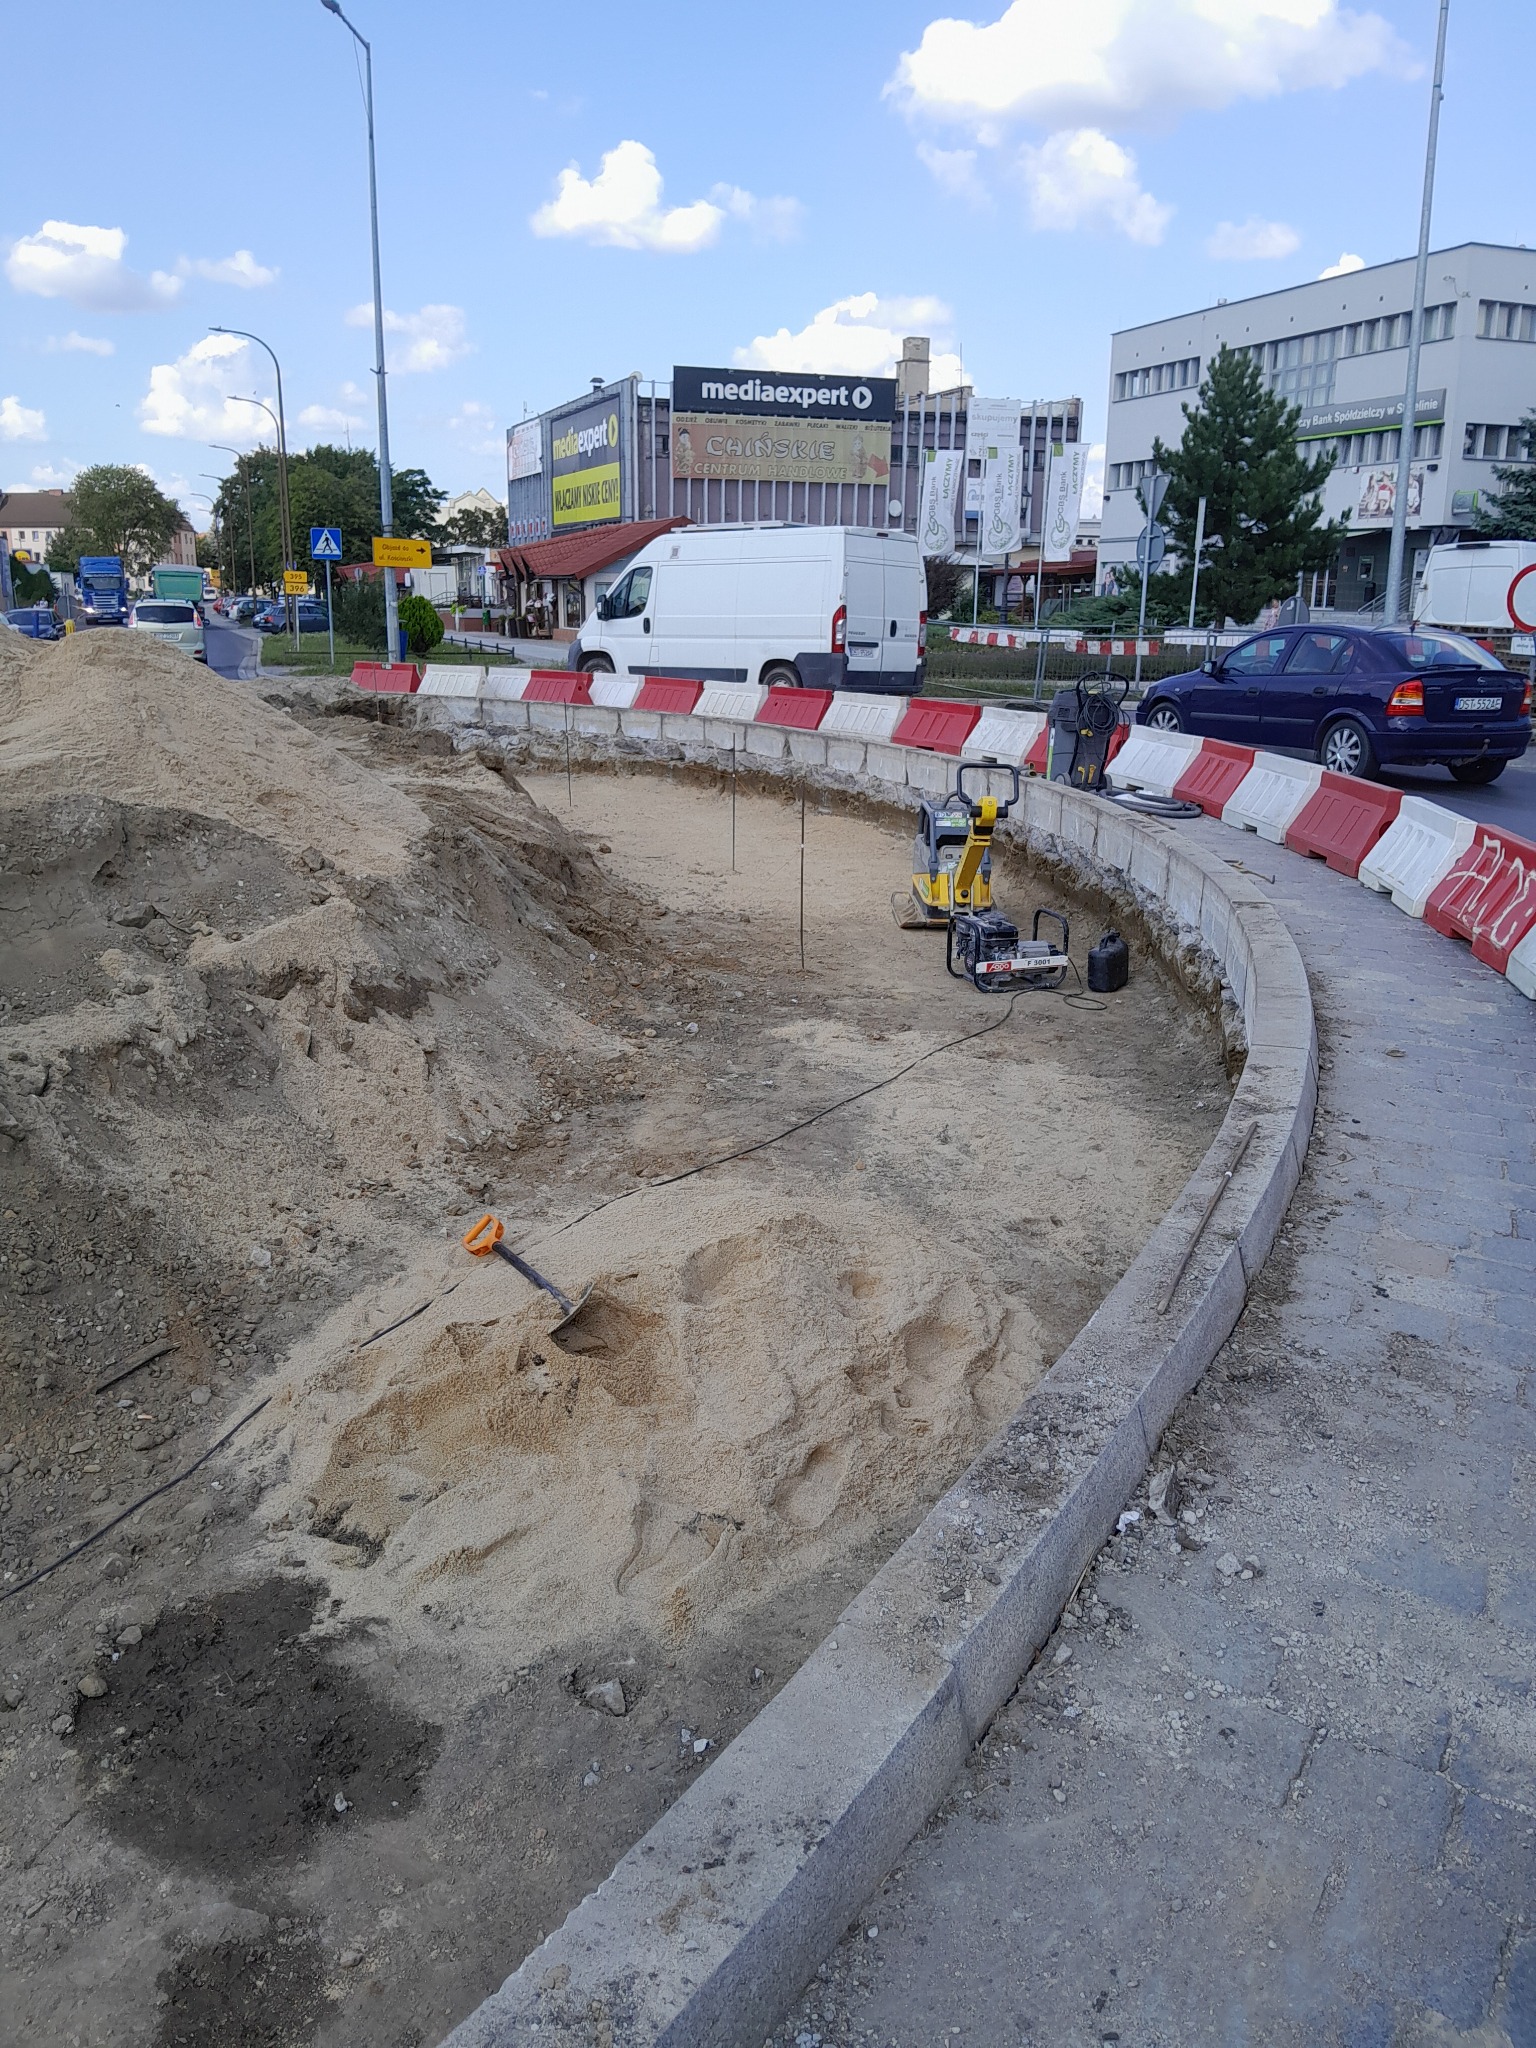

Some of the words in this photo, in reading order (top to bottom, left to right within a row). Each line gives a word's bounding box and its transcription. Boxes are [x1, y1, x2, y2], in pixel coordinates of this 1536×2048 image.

[702, 379, 848, 408] mediaexpert
[1312, 414, 1334, 426] Bank
[1334, 407, 1385, 424] Spółdzielczy
[1387, 407, 1395, 415] w
[553, 418, 607, 461] mediaexpert
[706, 431, 836, 461] CHIŃSKIE
[694, 462, 761, 476] CENTRUM
[767, 464, 847, 479] HANDLOWE
[943, 458, 953, 499] ŁĄCZYMY
[1072, 451, 1080, 494] ŁĄCZYMY
